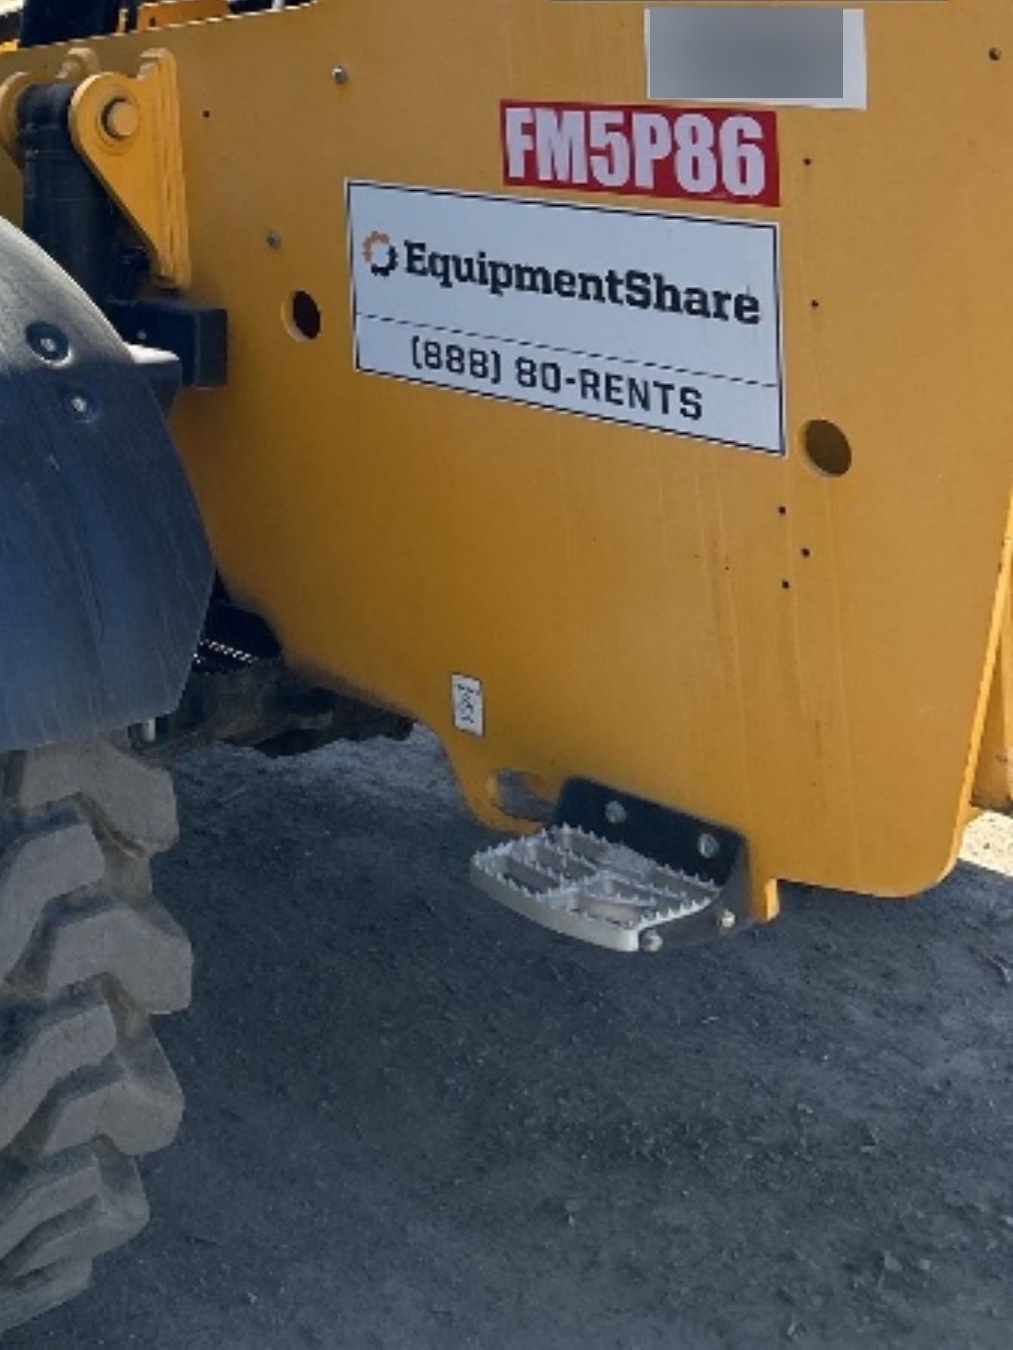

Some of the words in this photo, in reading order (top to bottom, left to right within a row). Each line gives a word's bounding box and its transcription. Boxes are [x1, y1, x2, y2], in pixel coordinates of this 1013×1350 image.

[504, 107, 766, 197] FM5P86
[403, 239, 761, 326] EquipmentShare
[410, 335, 503, 385] (888)
[514, 355, 705, 421] 80-RENTS
